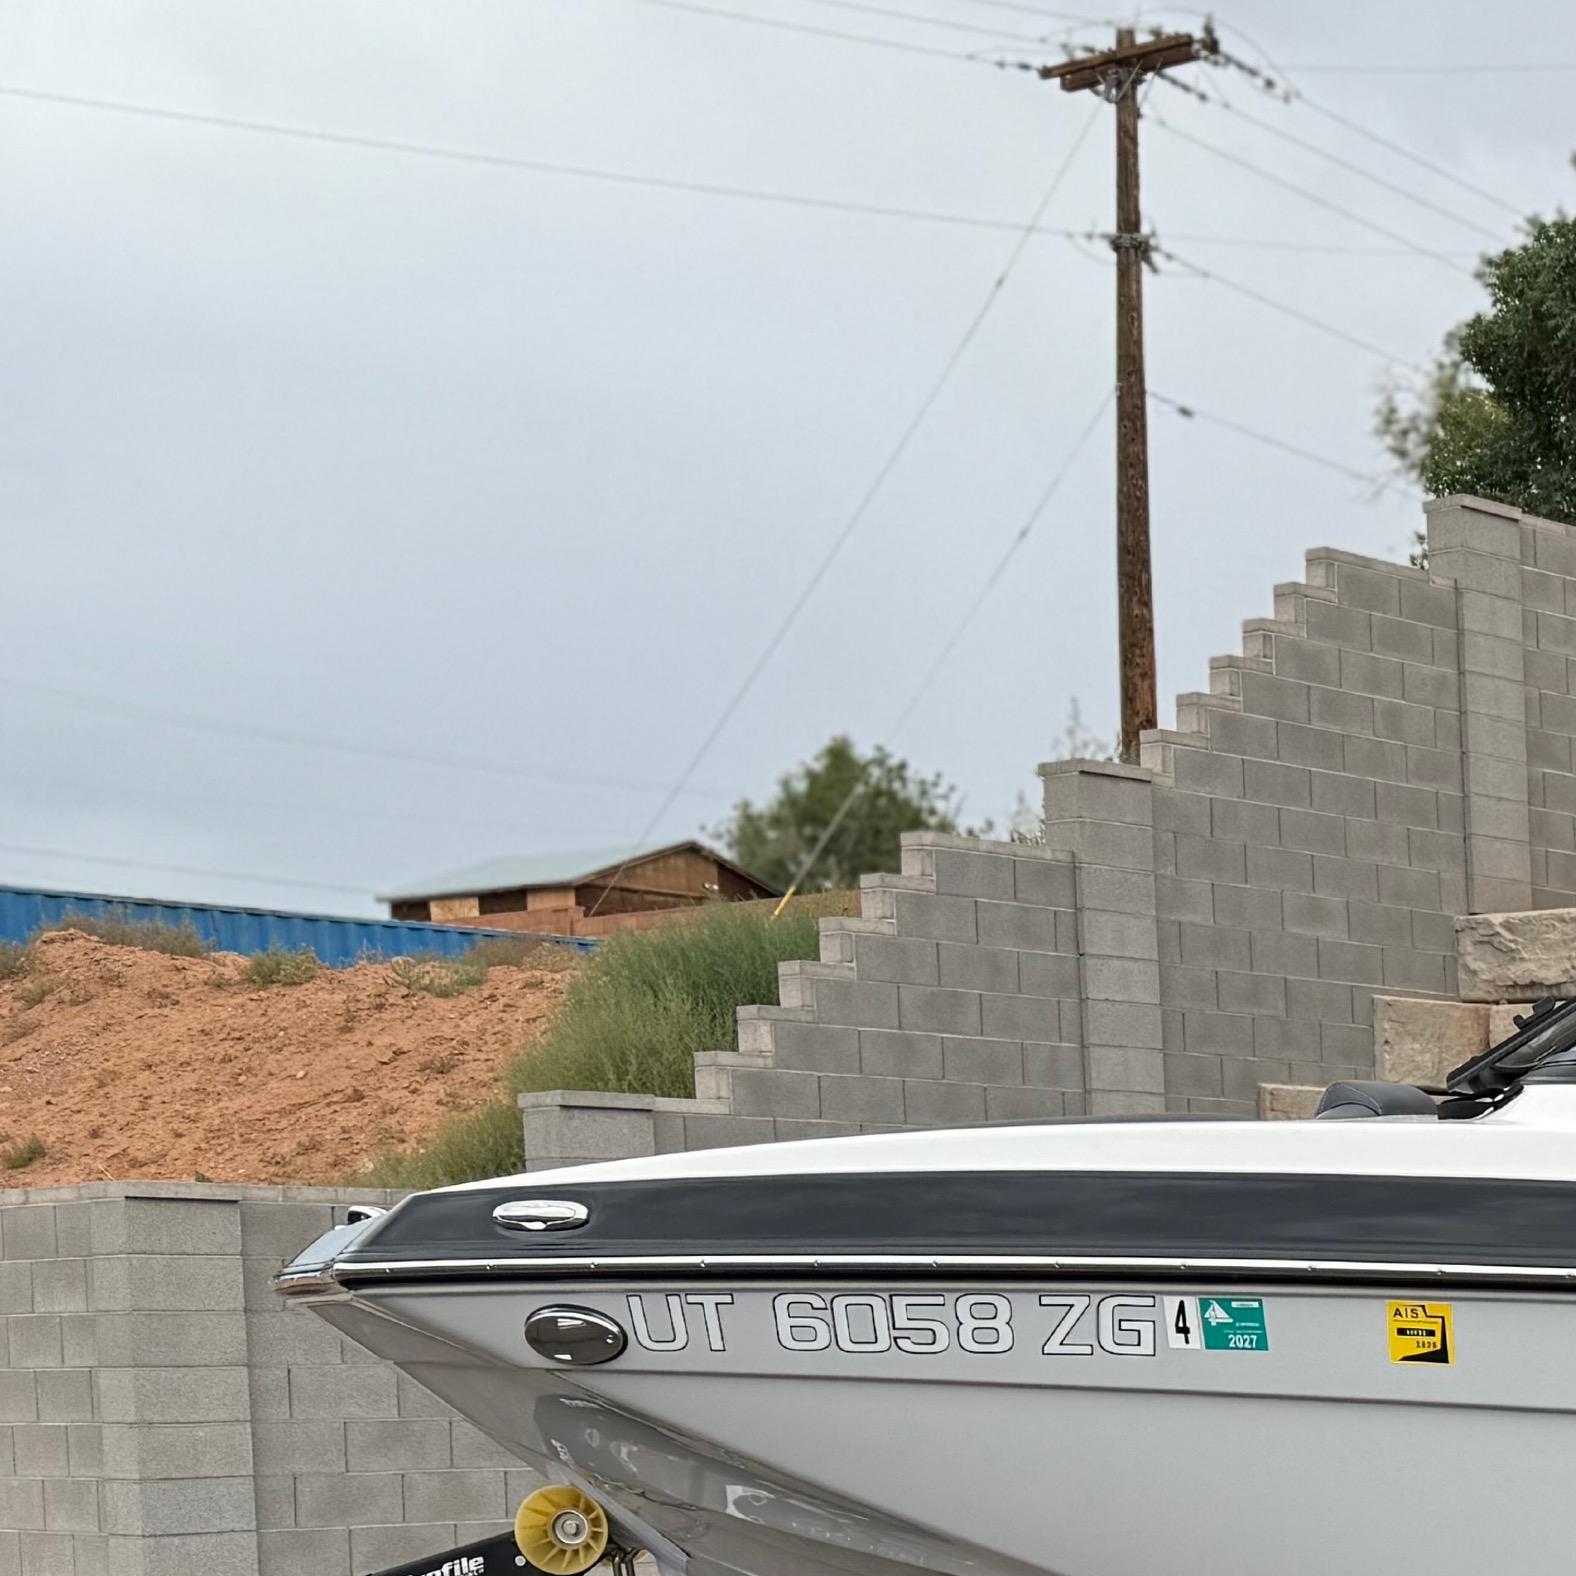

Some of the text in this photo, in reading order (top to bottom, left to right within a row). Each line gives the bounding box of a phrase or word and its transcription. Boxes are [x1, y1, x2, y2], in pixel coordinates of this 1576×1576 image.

[626, 1292, 1157, 1357] UT 6058 ZG
[1174, 1299, 1191, 1345] 4
[1393, 1307, 1419, 1319] AIS
[1227, 1334, 1258, 1349] 2027
